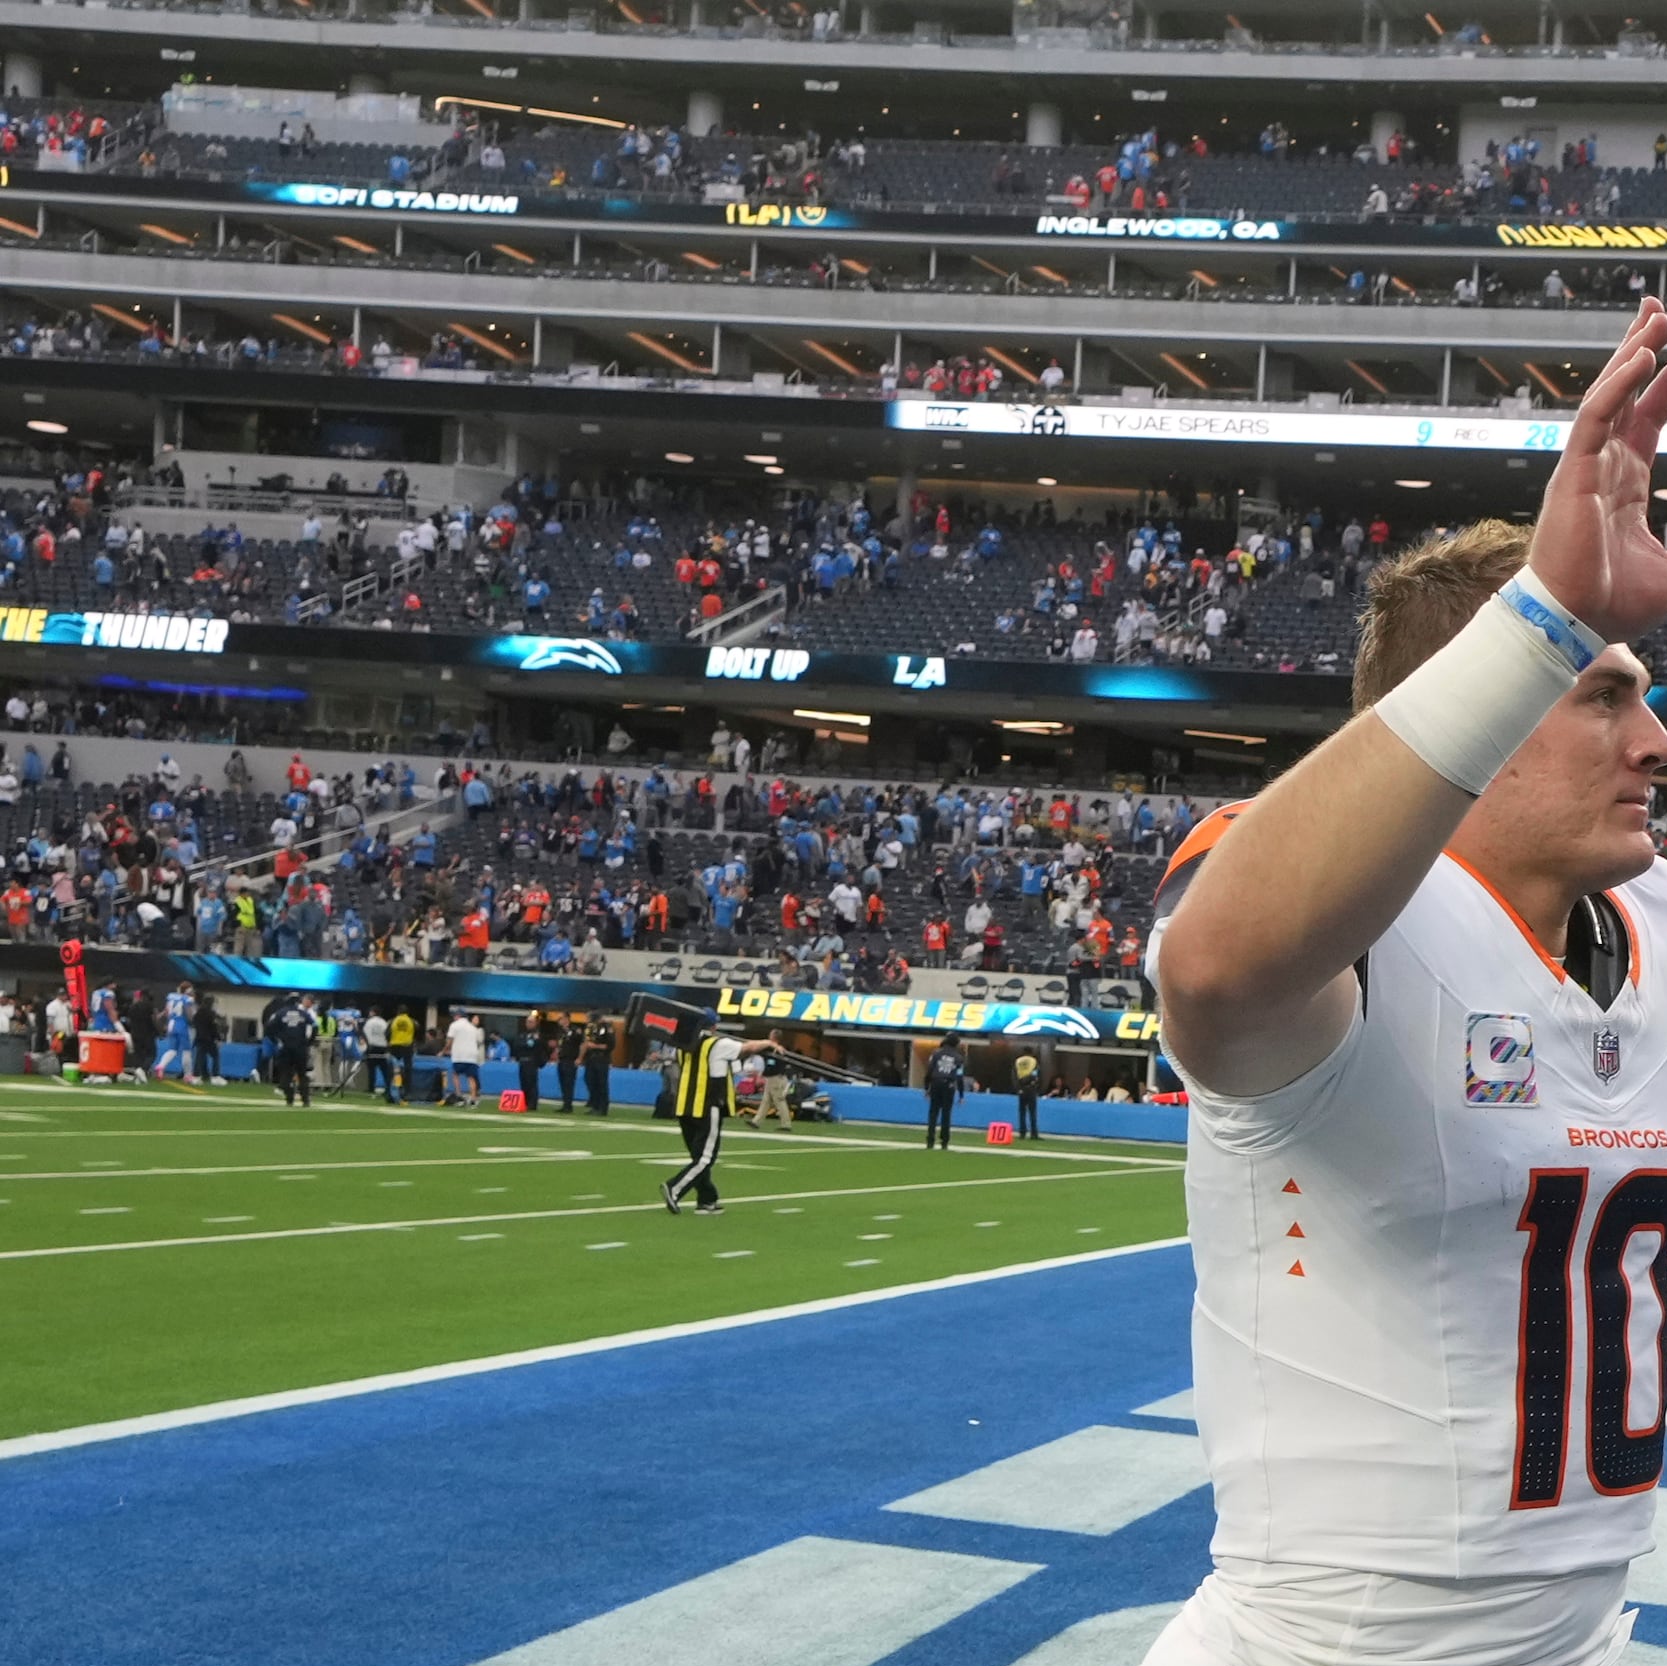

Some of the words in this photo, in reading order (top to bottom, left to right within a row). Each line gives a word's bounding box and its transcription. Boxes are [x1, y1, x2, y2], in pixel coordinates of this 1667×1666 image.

[370, 189, 519, 213] STADIUM
[1037, 215, 1227, 240] INGLEWOOD,
[1231, 221, 1280, 240] CA
[1178, 416, 1270, 435] SPEARS
[1417, 421, 1433, 445] 9
[1454, 428, 1489, 441] REC
[1523, 423, 1560, 447] 28
[81, 611, 229, 653] THUNDER
[705, 646, 771, 679] BOLT
[770, 648, 810, 681] UP
[893, 655, 947, 689] LA
[717, 987, 797, 1018] LOS
[800, 993, 988, 1031] ANGELES
[1471, 1018, 1534, 1082] C
[1598, 1051, 1617, 1071] NFL
[501, 1093, 520, 1109] 20
[990, 1125, 1006, 1141] 10
